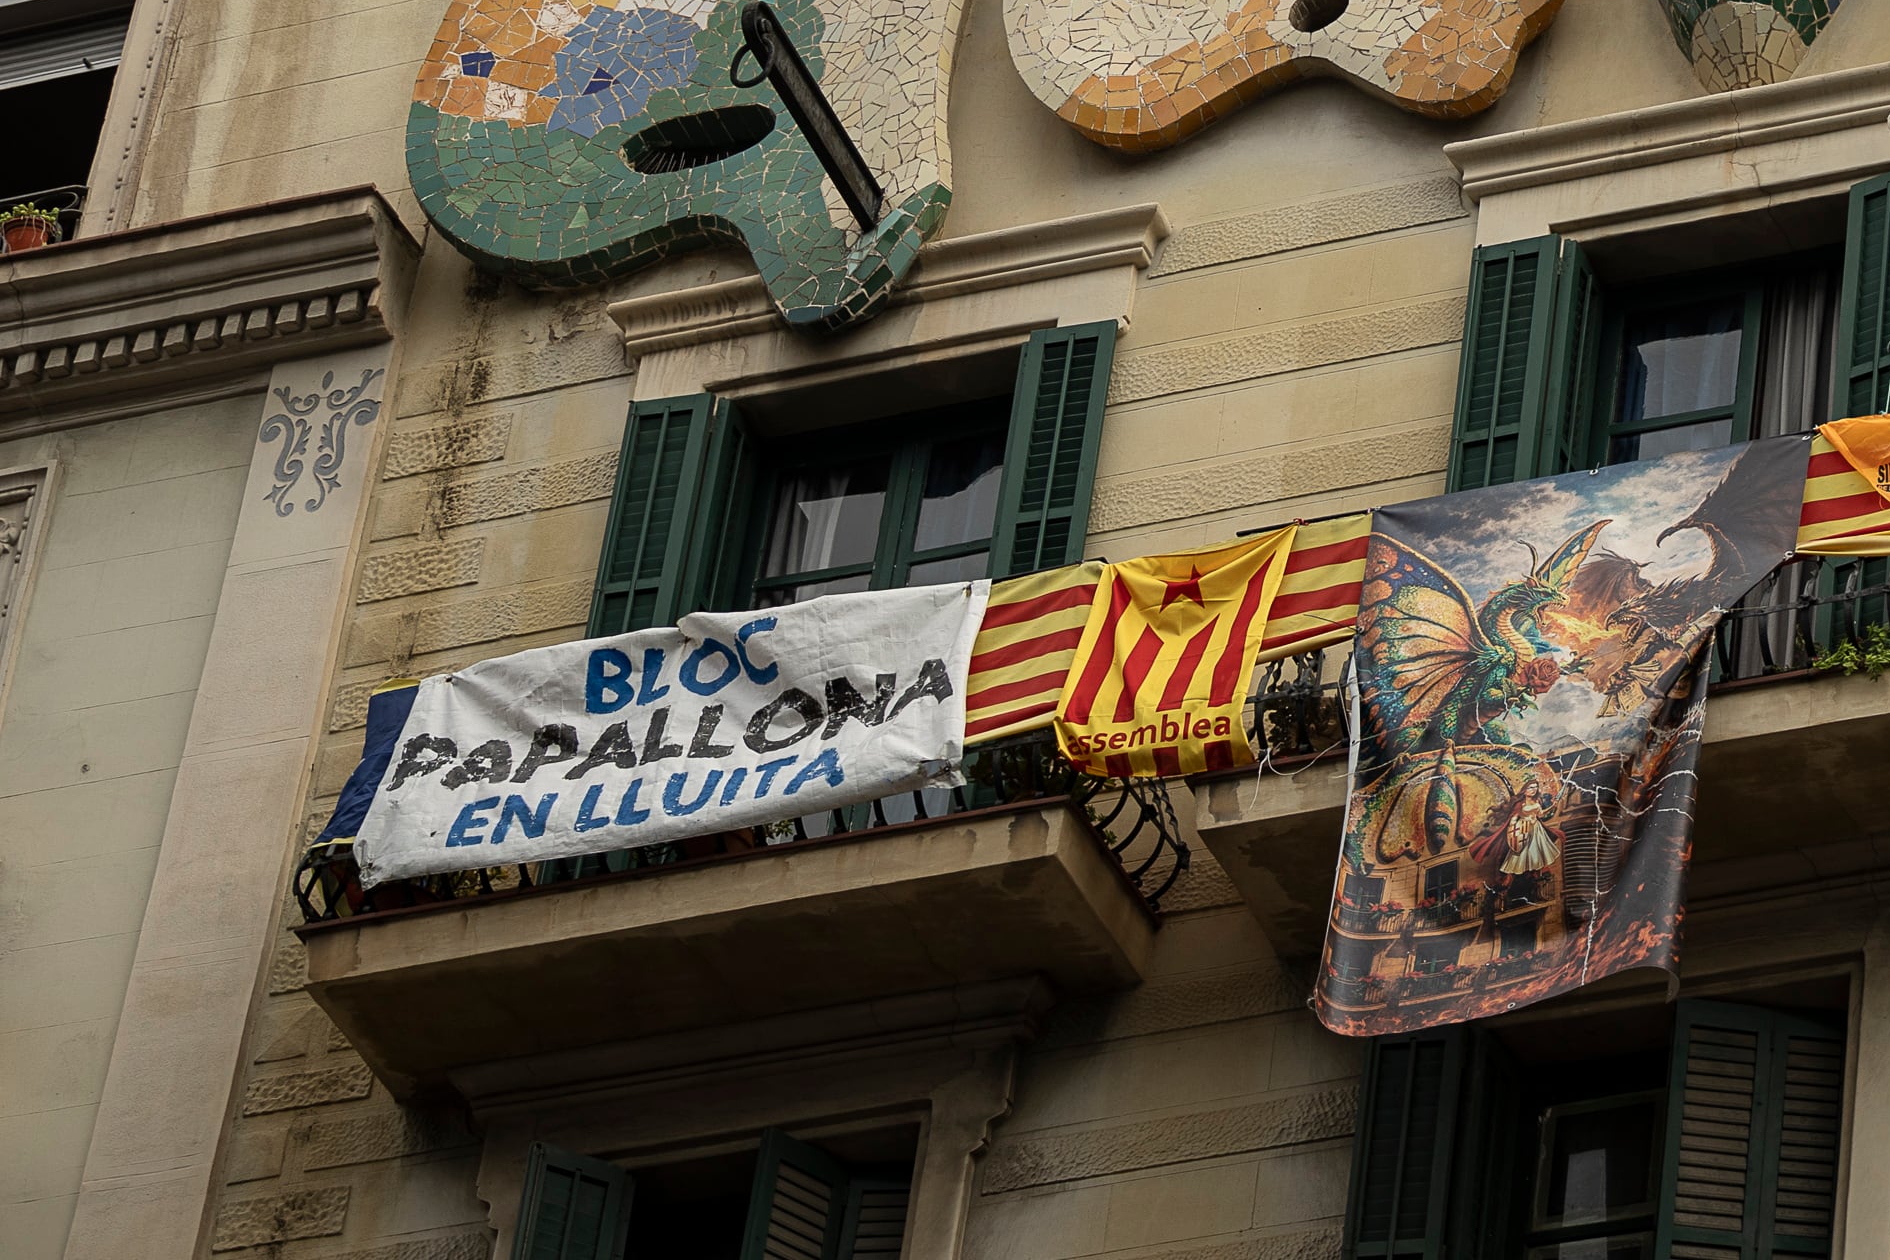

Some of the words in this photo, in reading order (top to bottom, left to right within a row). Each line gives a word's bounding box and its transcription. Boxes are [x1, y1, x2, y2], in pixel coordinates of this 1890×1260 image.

[585, 616, 777, 714] BLOC
[387, 658, 955, 791] PAPALLONA
[1066, 712, 1231, 756] assemblea
[446, 792, 558, 847] EN
[574, 747, 844, 833] LLUITA
